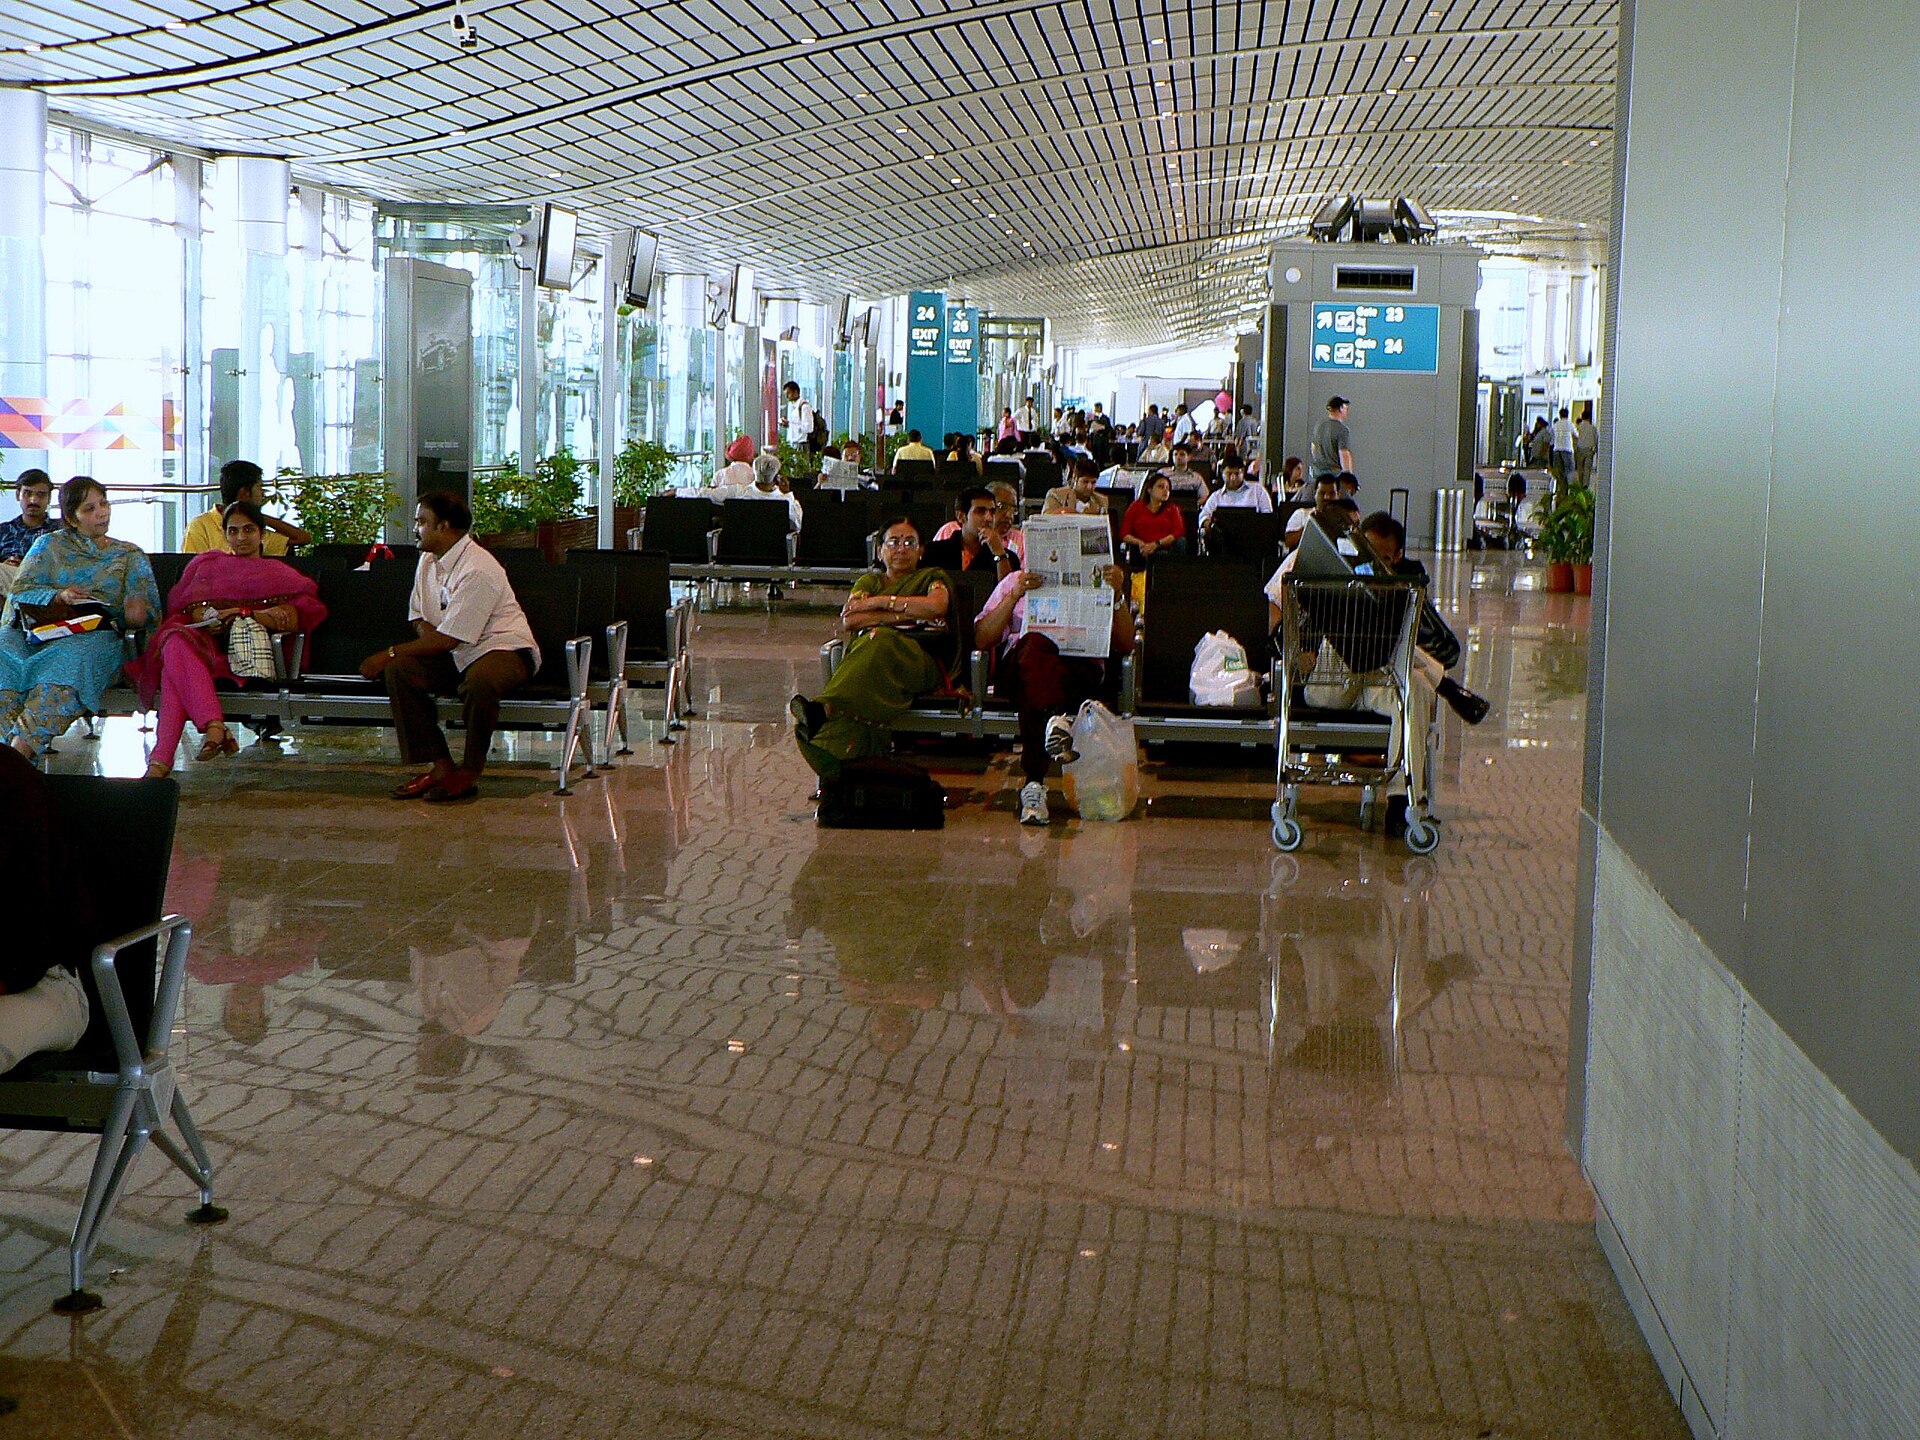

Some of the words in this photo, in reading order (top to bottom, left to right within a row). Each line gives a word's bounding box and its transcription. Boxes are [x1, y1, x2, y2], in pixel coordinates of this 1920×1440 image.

[916, 306, 935, 321] 24
[1385, 307, 1404, 323] 23
[912, 328, 939, 341] EXIT
[948, 339, 972, 350] EXIT
[1384, 338, 1403, 354] 24
